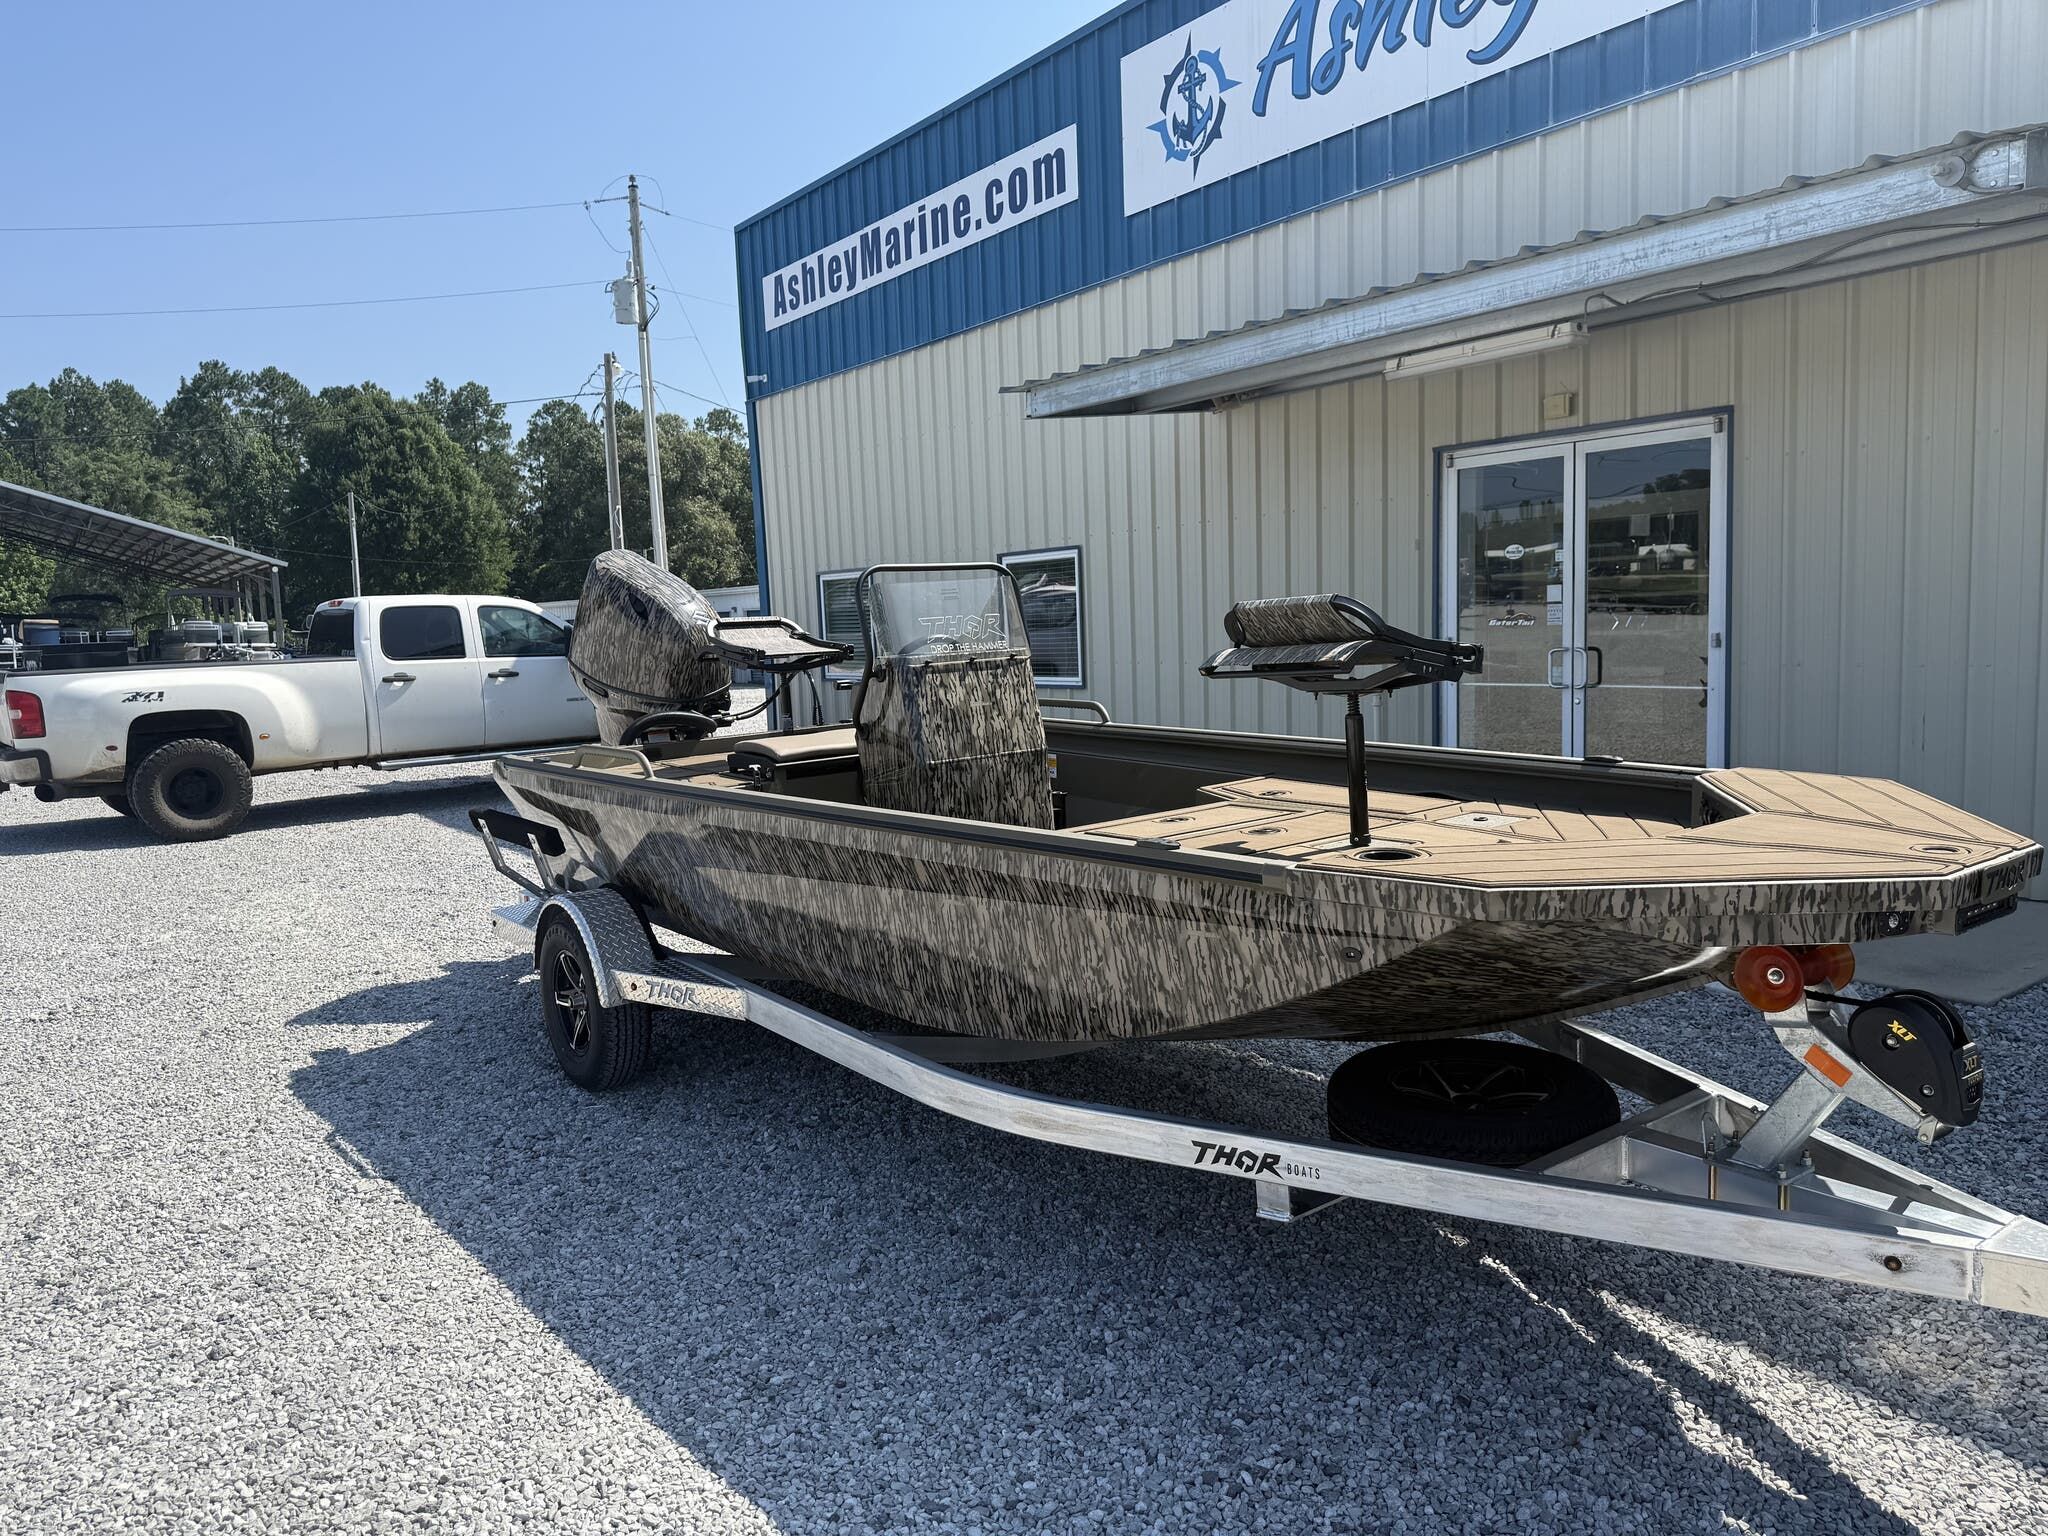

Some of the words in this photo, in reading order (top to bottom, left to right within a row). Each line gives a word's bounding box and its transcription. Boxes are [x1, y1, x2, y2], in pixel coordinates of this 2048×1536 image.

[773, 147, 1067, 318] AshleyMarine.com
[918, 613, 1008, 643] THOR
[930, 644, 955, 654] DROP
[955, 642, 971, 652] THE
[972, 640, 1009, 651] HAMMER
[1986, 861, 2024, 897] THOR
[646, 980, 700, 1006] THOR
[1887, 1019, 1918, 1041] XLT
[1191, 1140, 1285, 1180] THOR
[1287, 1163, 1320, 1180] BOATS
